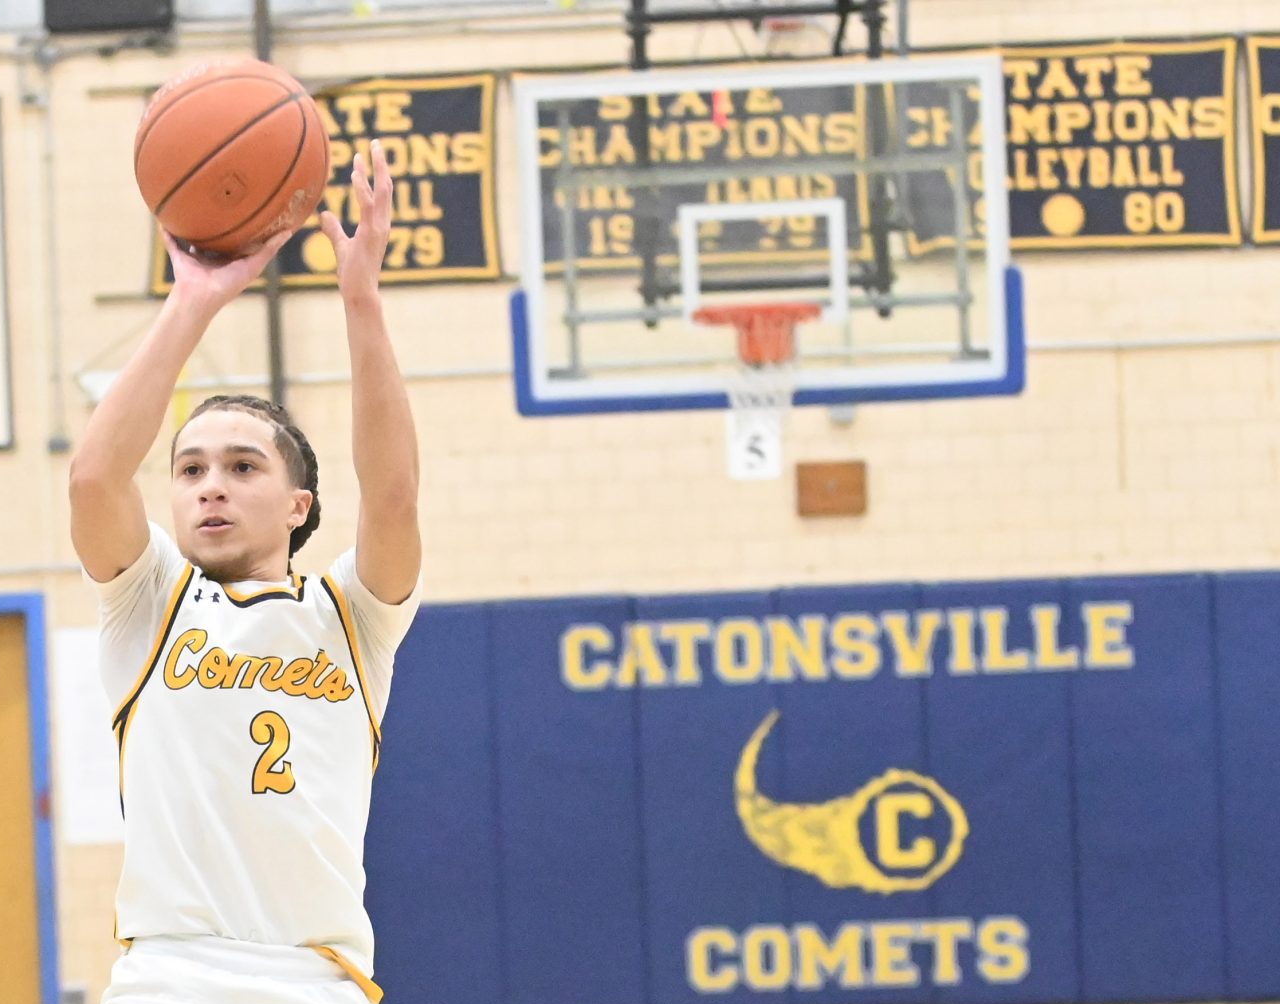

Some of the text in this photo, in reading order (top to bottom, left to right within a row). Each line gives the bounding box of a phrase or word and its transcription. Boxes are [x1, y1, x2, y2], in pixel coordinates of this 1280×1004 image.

[966, 56, 1152, 100] TATE
[385, 225, 444, 268] 79
[1124, 191, 1185, 234] 80
[163, 628, 355, 703] Comets
[559, 601, 1136, 691] CATONSVILLE
[249, 710, 296, 795] 2
[875, 793, 937, 870] C
[686, 917, 1031, 994] COMETS
